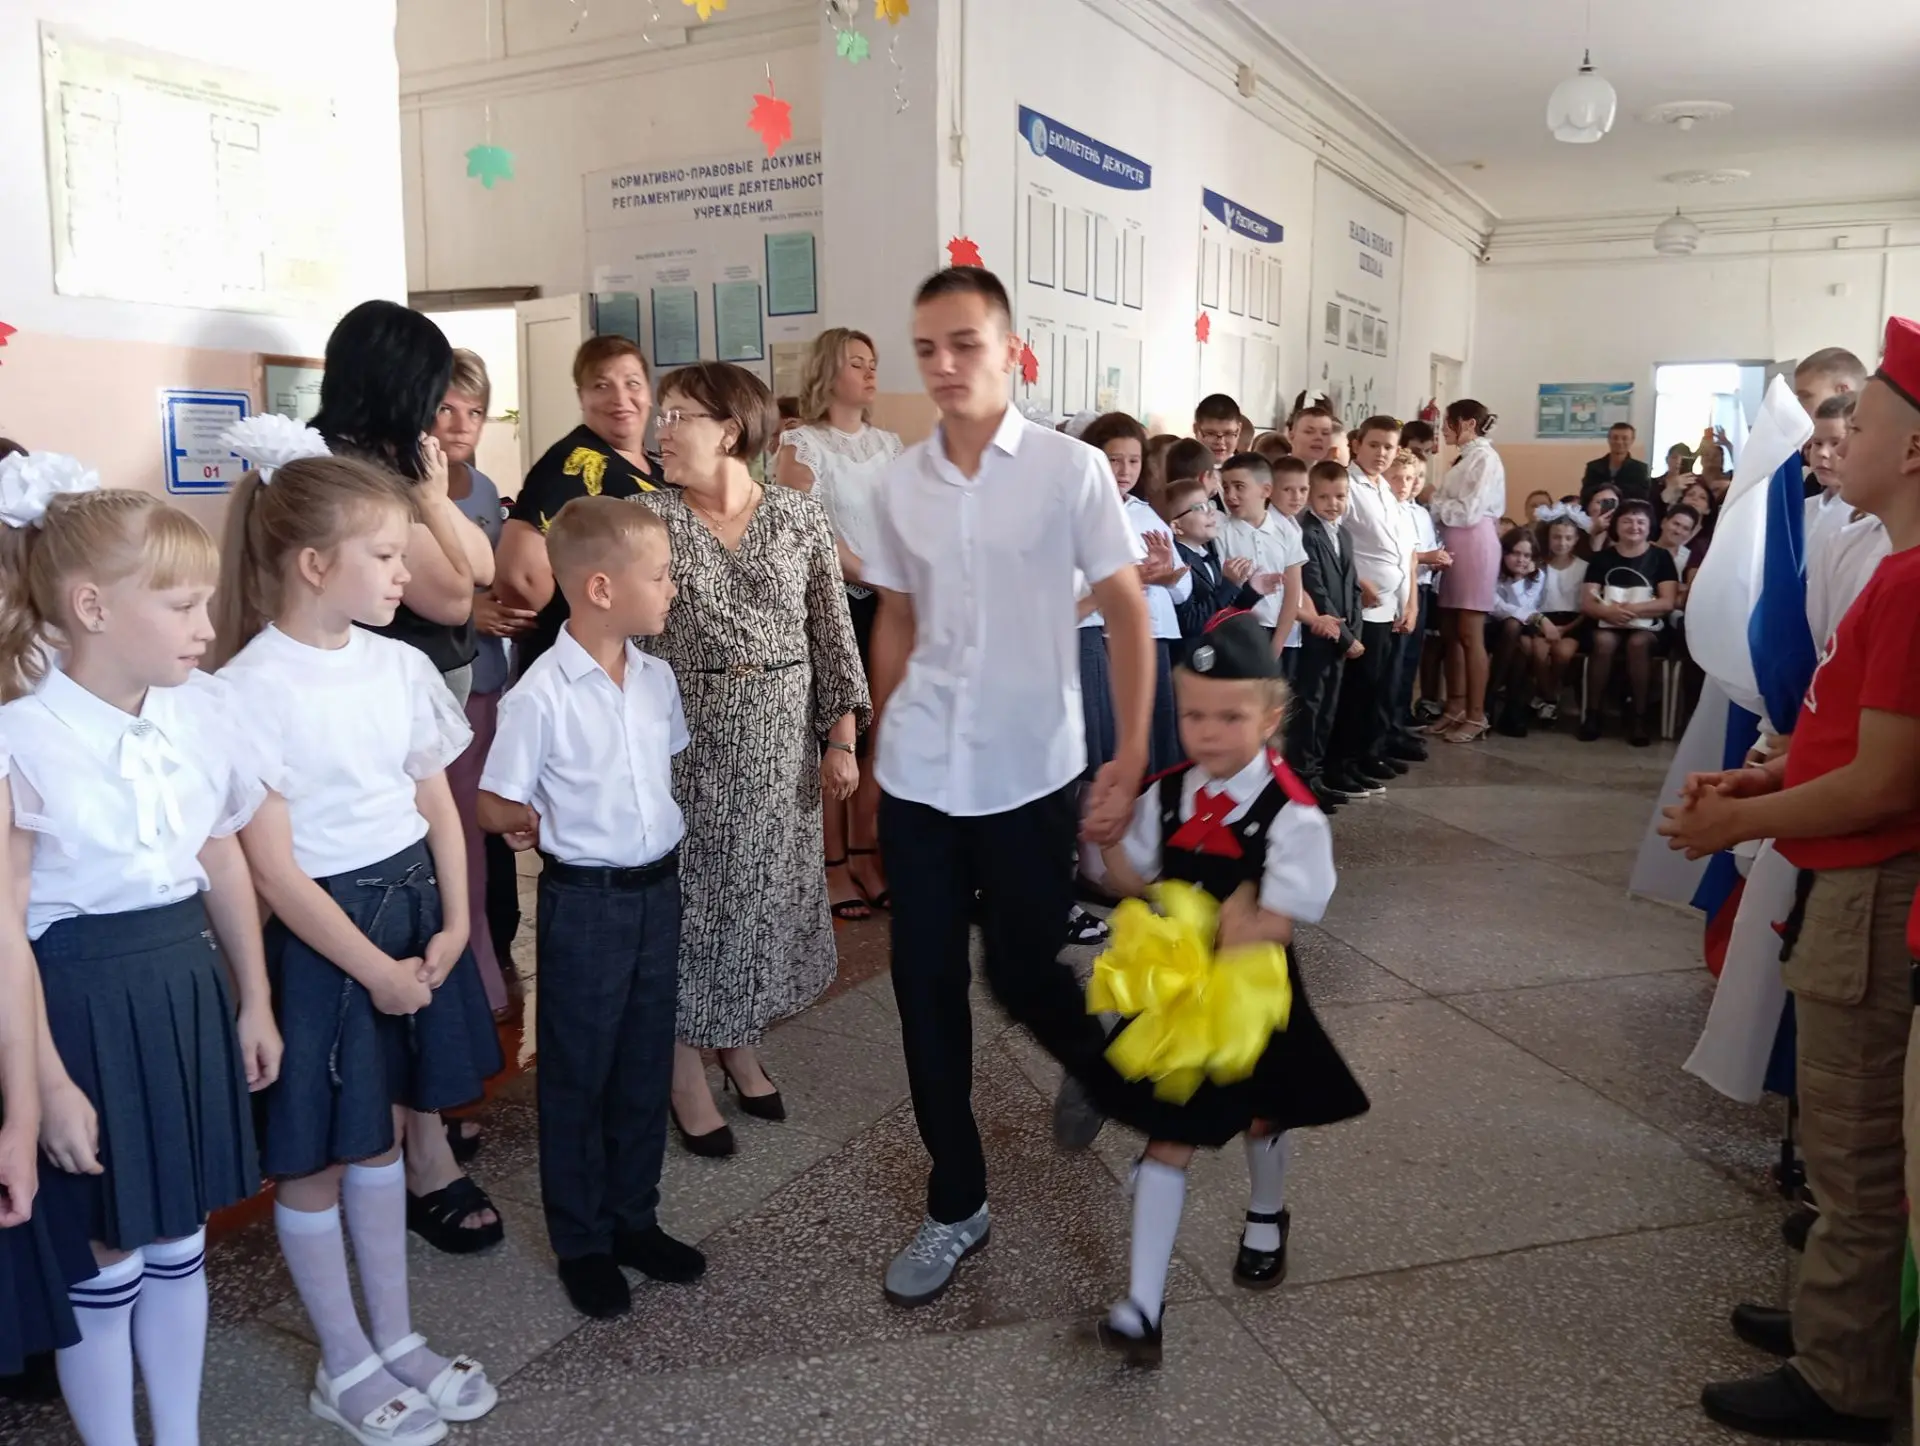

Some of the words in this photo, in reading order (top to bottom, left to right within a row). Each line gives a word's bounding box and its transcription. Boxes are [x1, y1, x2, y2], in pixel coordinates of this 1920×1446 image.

[1048, 130, 1101, 165] БЮЛЛЕТЕНЬ
[1102, 154, 1145, 184] ДЕЖУРСТВ
[611, 160, 754, 190] НОРМАТИВНО-ПРАВОВЫЕ
[612, 183, 735, 210] РЕГЛАМЕНТИРУЮЩИЕ
[693, 199, 773, 220] УЧРЕЖДЕНИЯ
[203, 465, 220, 478] 01
